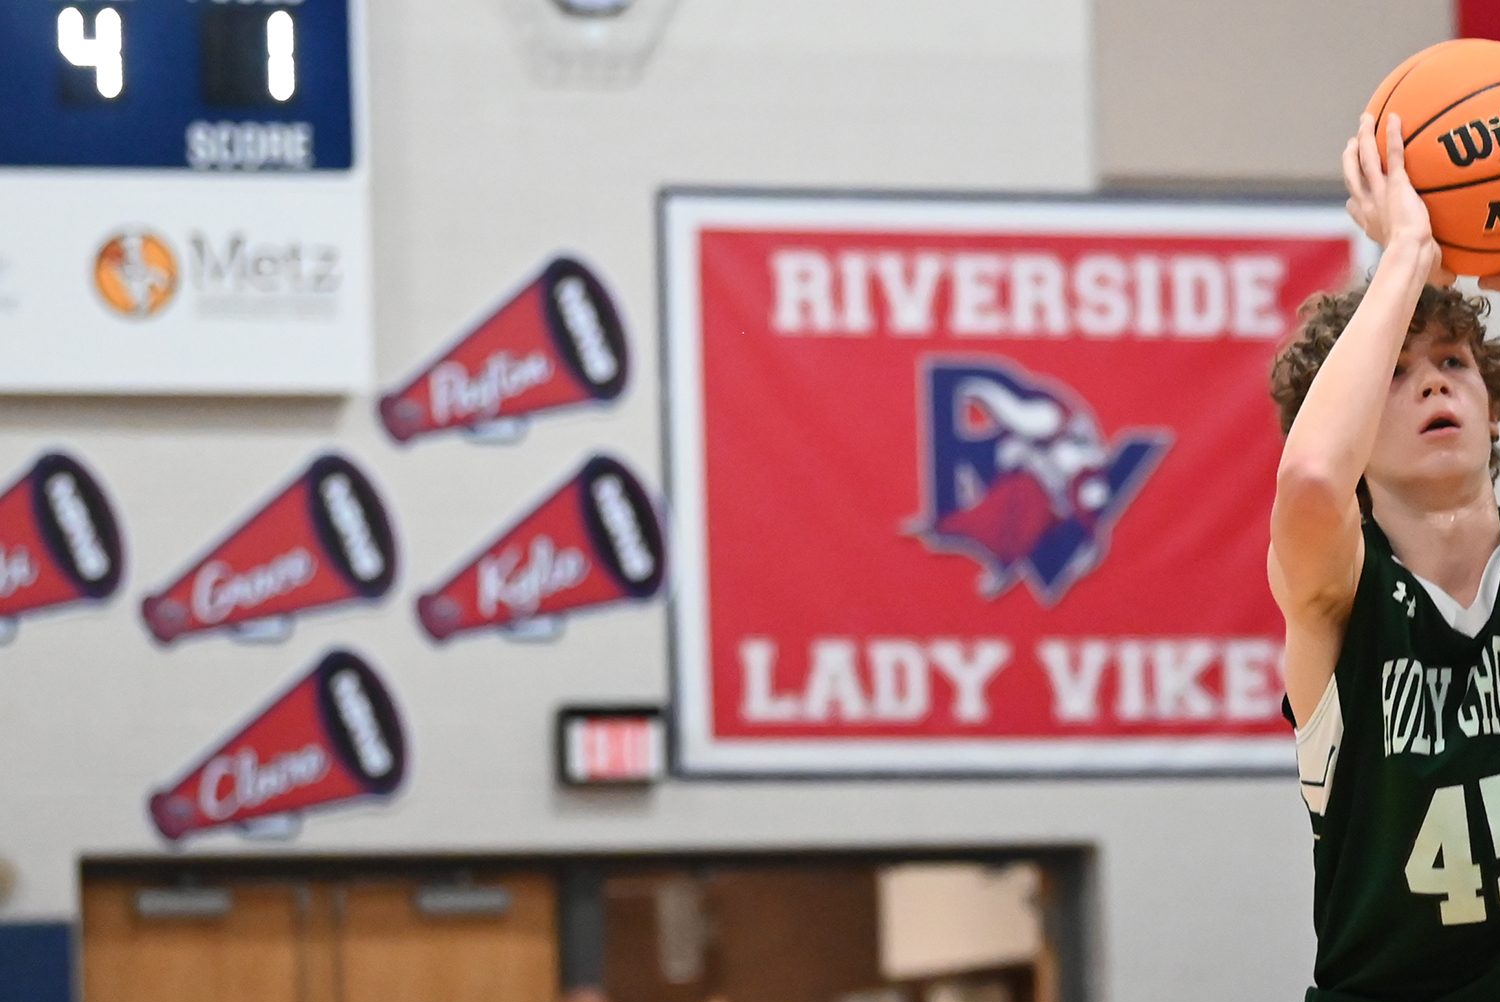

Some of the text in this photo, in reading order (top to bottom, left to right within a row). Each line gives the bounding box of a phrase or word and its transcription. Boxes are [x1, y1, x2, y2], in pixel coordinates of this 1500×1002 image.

[58, 7, 123, 98] 4
[267, 10, 295, 101] 1
[188, 121, 312, 168] SCORE
[188, 229, 342, 293] Metz
[772, 252, 1284, 338] RIVERSIDE
[738, 638, 1287, 722] LADY VIKE
[1382, 658, 1452, 758] HOLY
